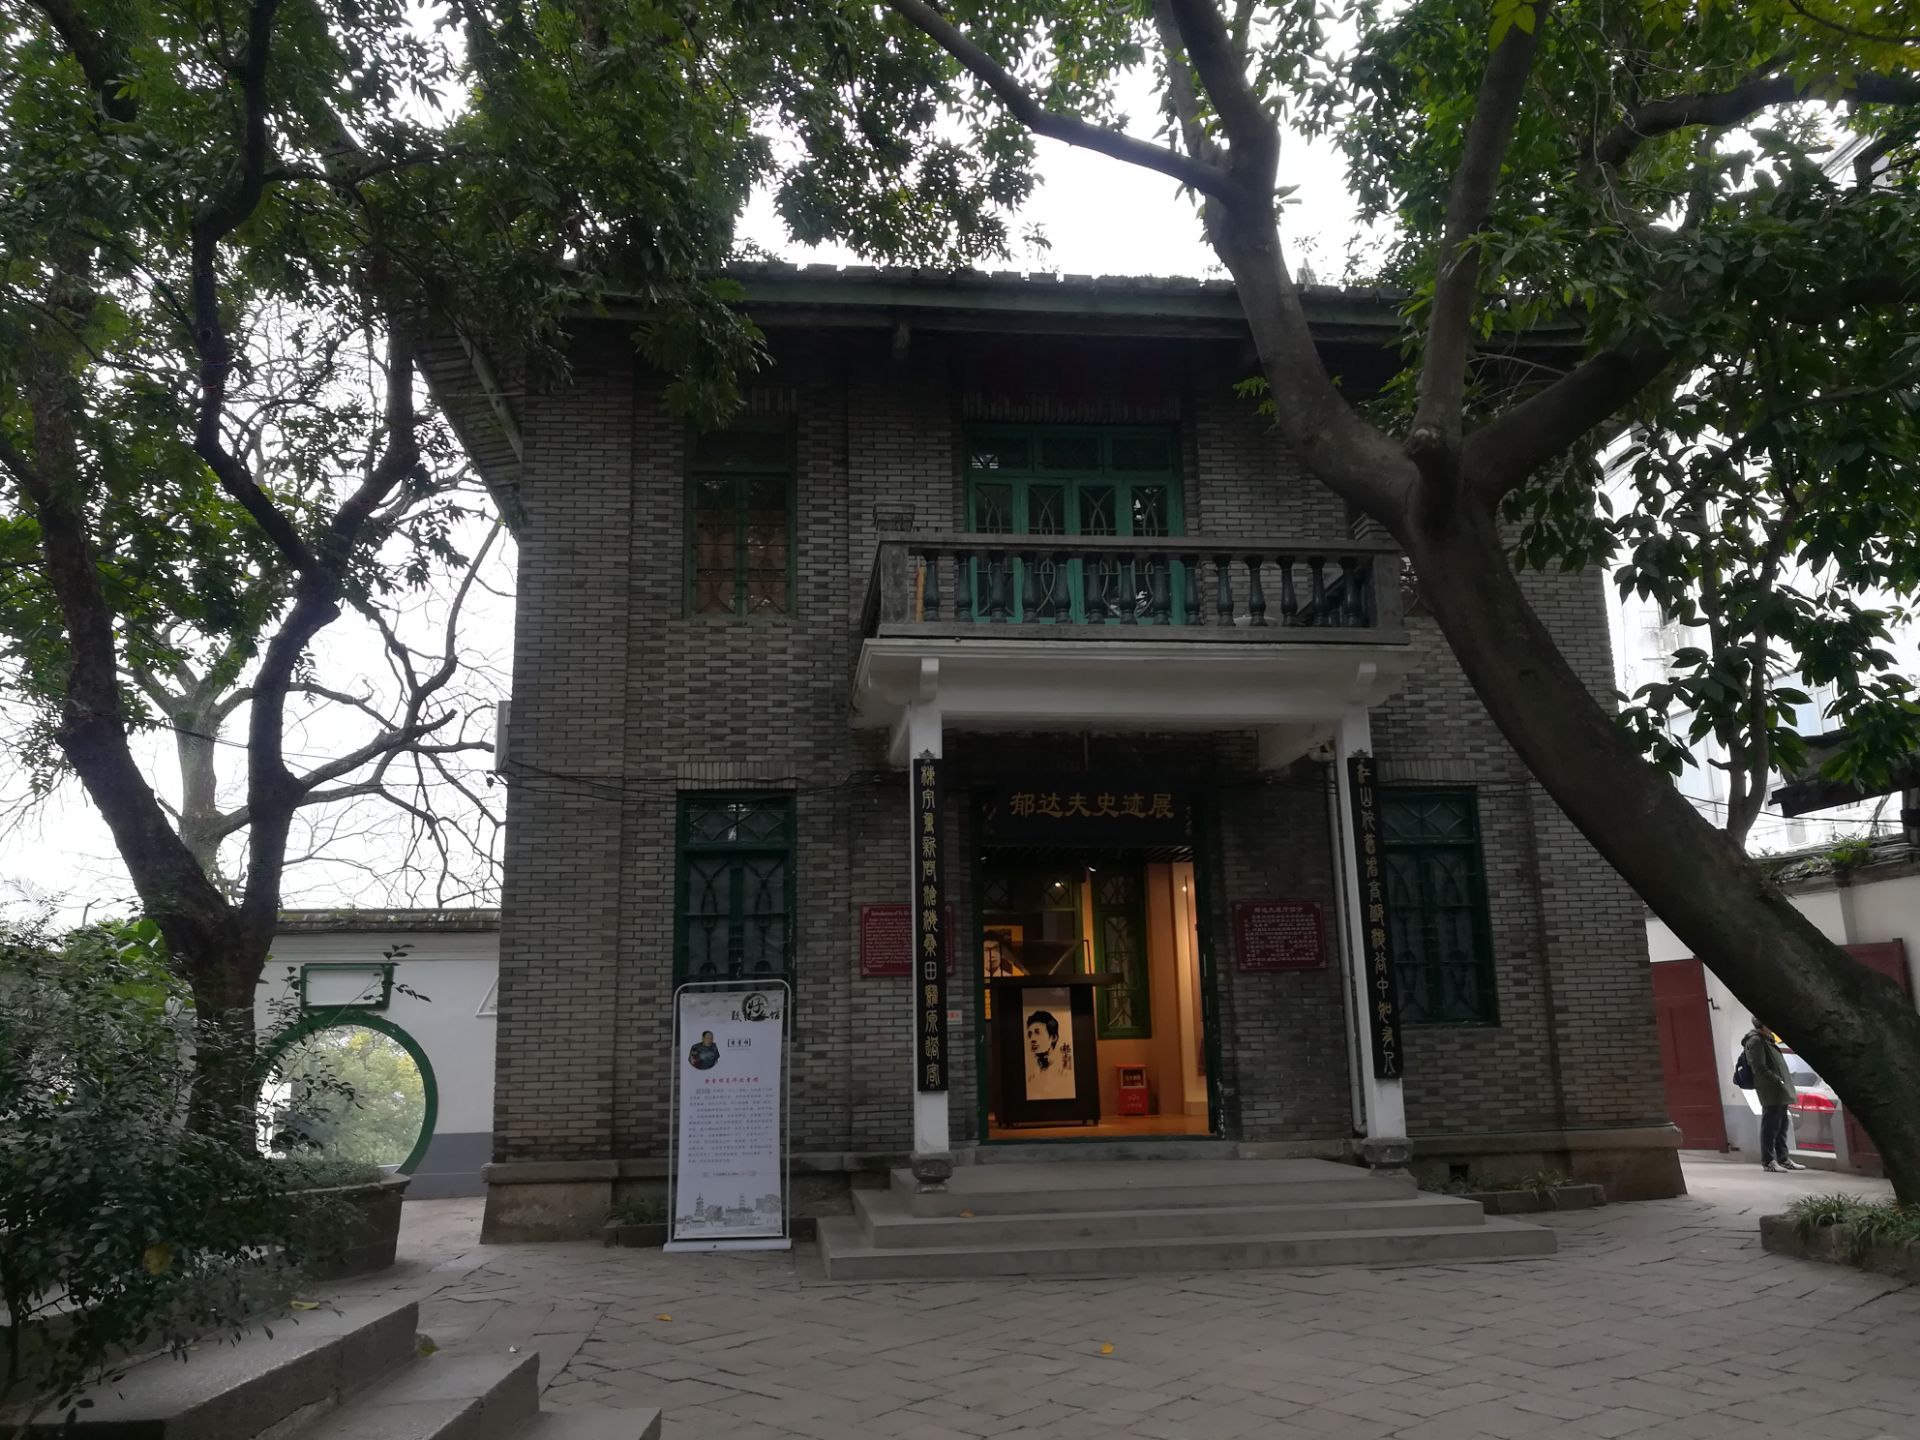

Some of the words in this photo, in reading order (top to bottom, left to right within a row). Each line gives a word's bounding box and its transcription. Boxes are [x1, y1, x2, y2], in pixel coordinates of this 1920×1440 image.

[1009, 792, 1175, 818] 郁达夫史迹展
